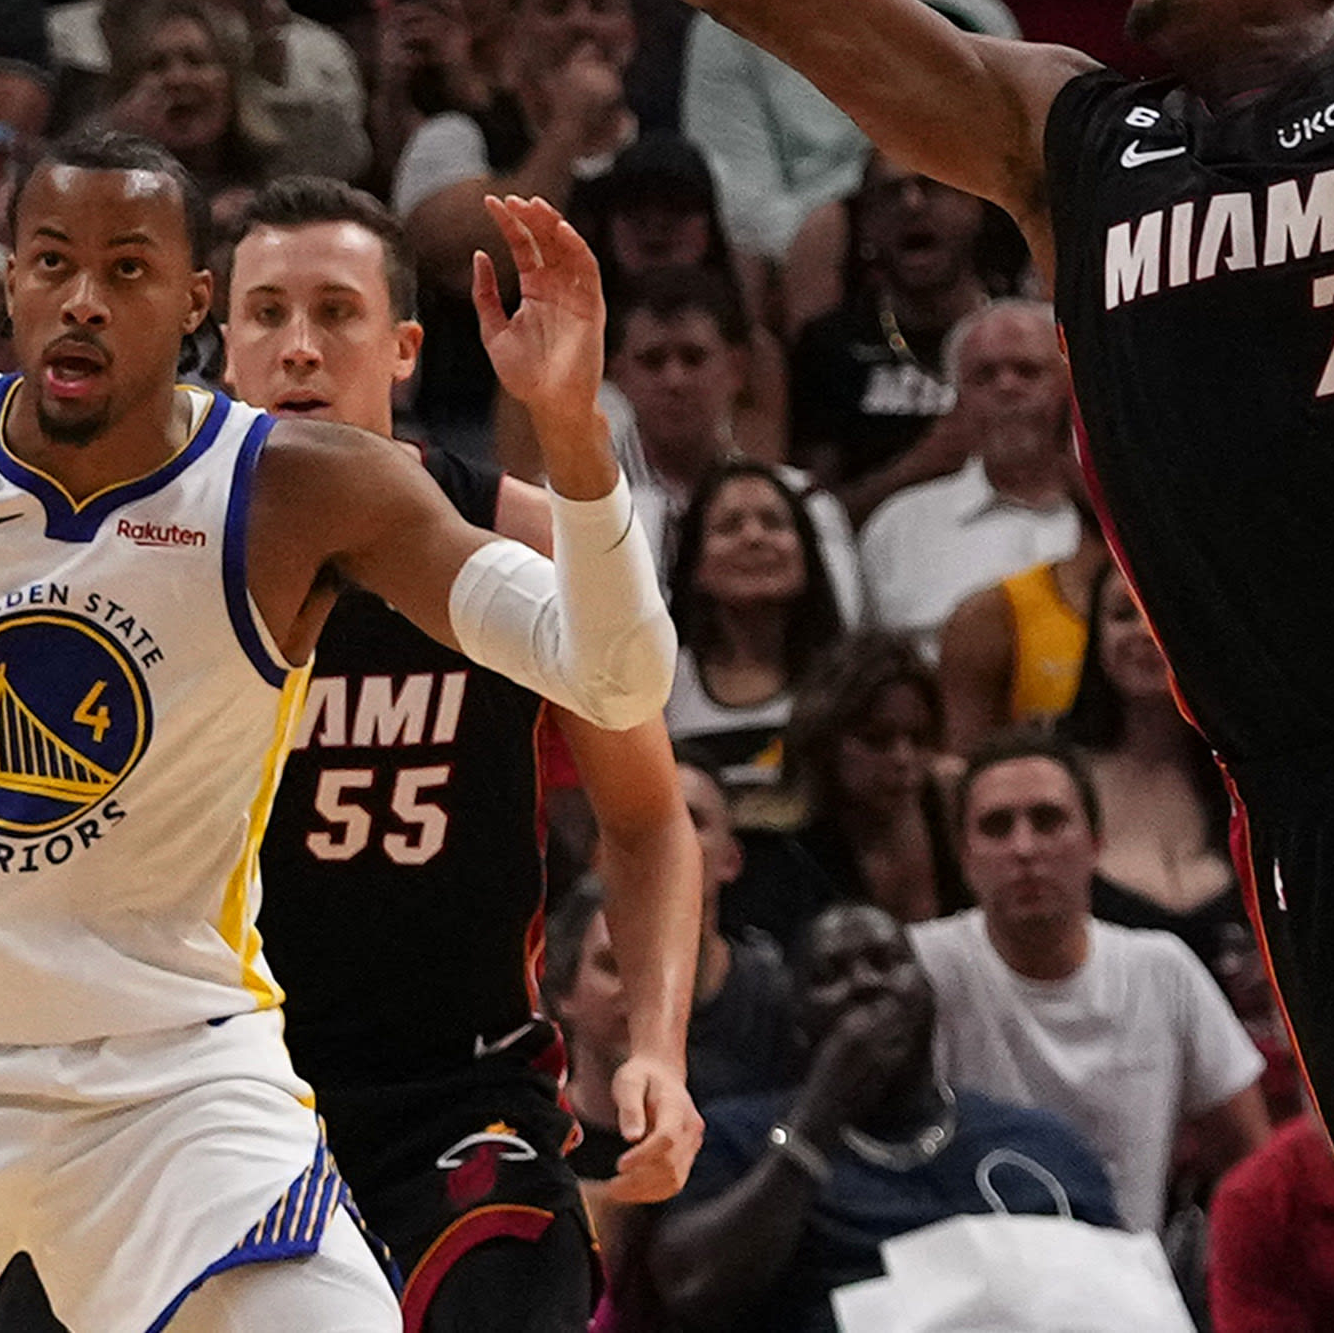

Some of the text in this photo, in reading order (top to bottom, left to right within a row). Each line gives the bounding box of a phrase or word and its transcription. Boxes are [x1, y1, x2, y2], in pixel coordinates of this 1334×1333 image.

[1124, 105, 1161, 128] 6
[116, 519, 206, 547] Rakuten
[85, 593, 165, 669] STATE
[73, 679, 112, 744] 4
[305, 764, 453, 866] 55
